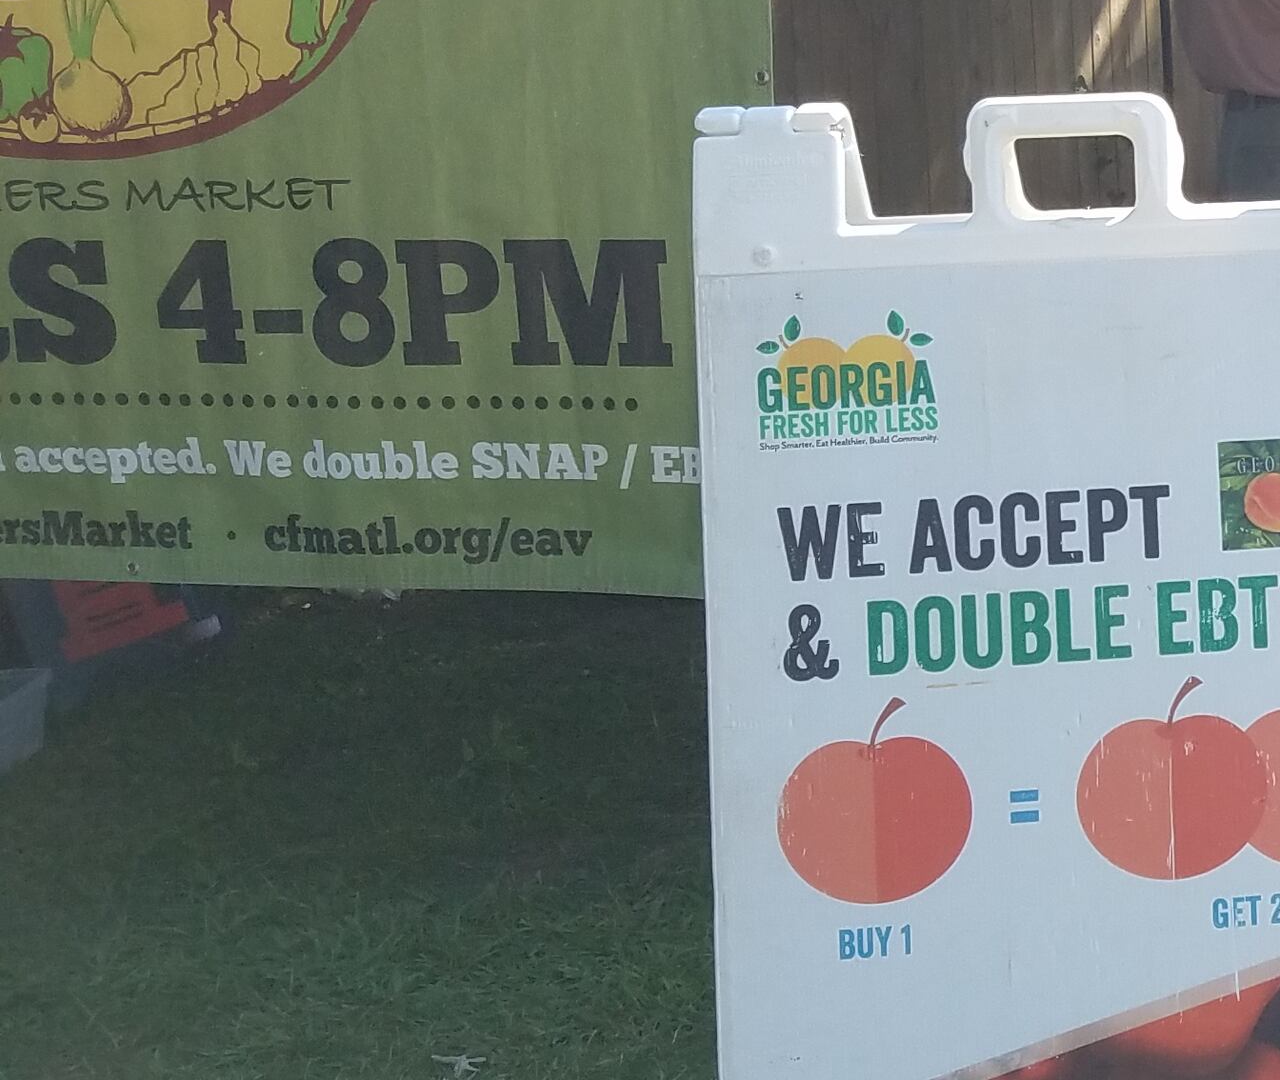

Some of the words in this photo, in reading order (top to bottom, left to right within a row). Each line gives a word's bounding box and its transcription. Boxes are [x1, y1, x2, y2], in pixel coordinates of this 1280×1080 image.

[126, 178, 350, 211] MARKET
[0, 237, 117, 365] S
[156, 237, 674, 366] 4-8PM
[757, 360, 936, 413] GEORGIA
[759, 412, 829, 440] FRESH
[837, 409, 878, 435] FOR
[885, 406, 939, 433] LESS
[759, 442, 778, 452] Shop
[816, 439, 829, 448] Eat
[869, 435, 889, 445] Build
[14, 437, 217, 484] accepted.
[224, 440, 293, 479] We
[303, 440, 459, 481] double
[472, 444, 608, 483] SNAP
[650, 445, 700, 484] EB
[0, 510, 192, 549] rsMarket
[264, 516, 593, 564] cfmatl.org/eav
[777, 502, 885, 582] WE
[909, 485, 1170, 574] ACCEPT
[783, 604, 840, 682] &
[867, 584, 1132, 676] DOUBLE
[1157, 575, 1279, 657] EBT
[1211, 896, 1264, 929] GET
[838, 927, 892, 960] BUY
[900, 925, 913, 955] 1
